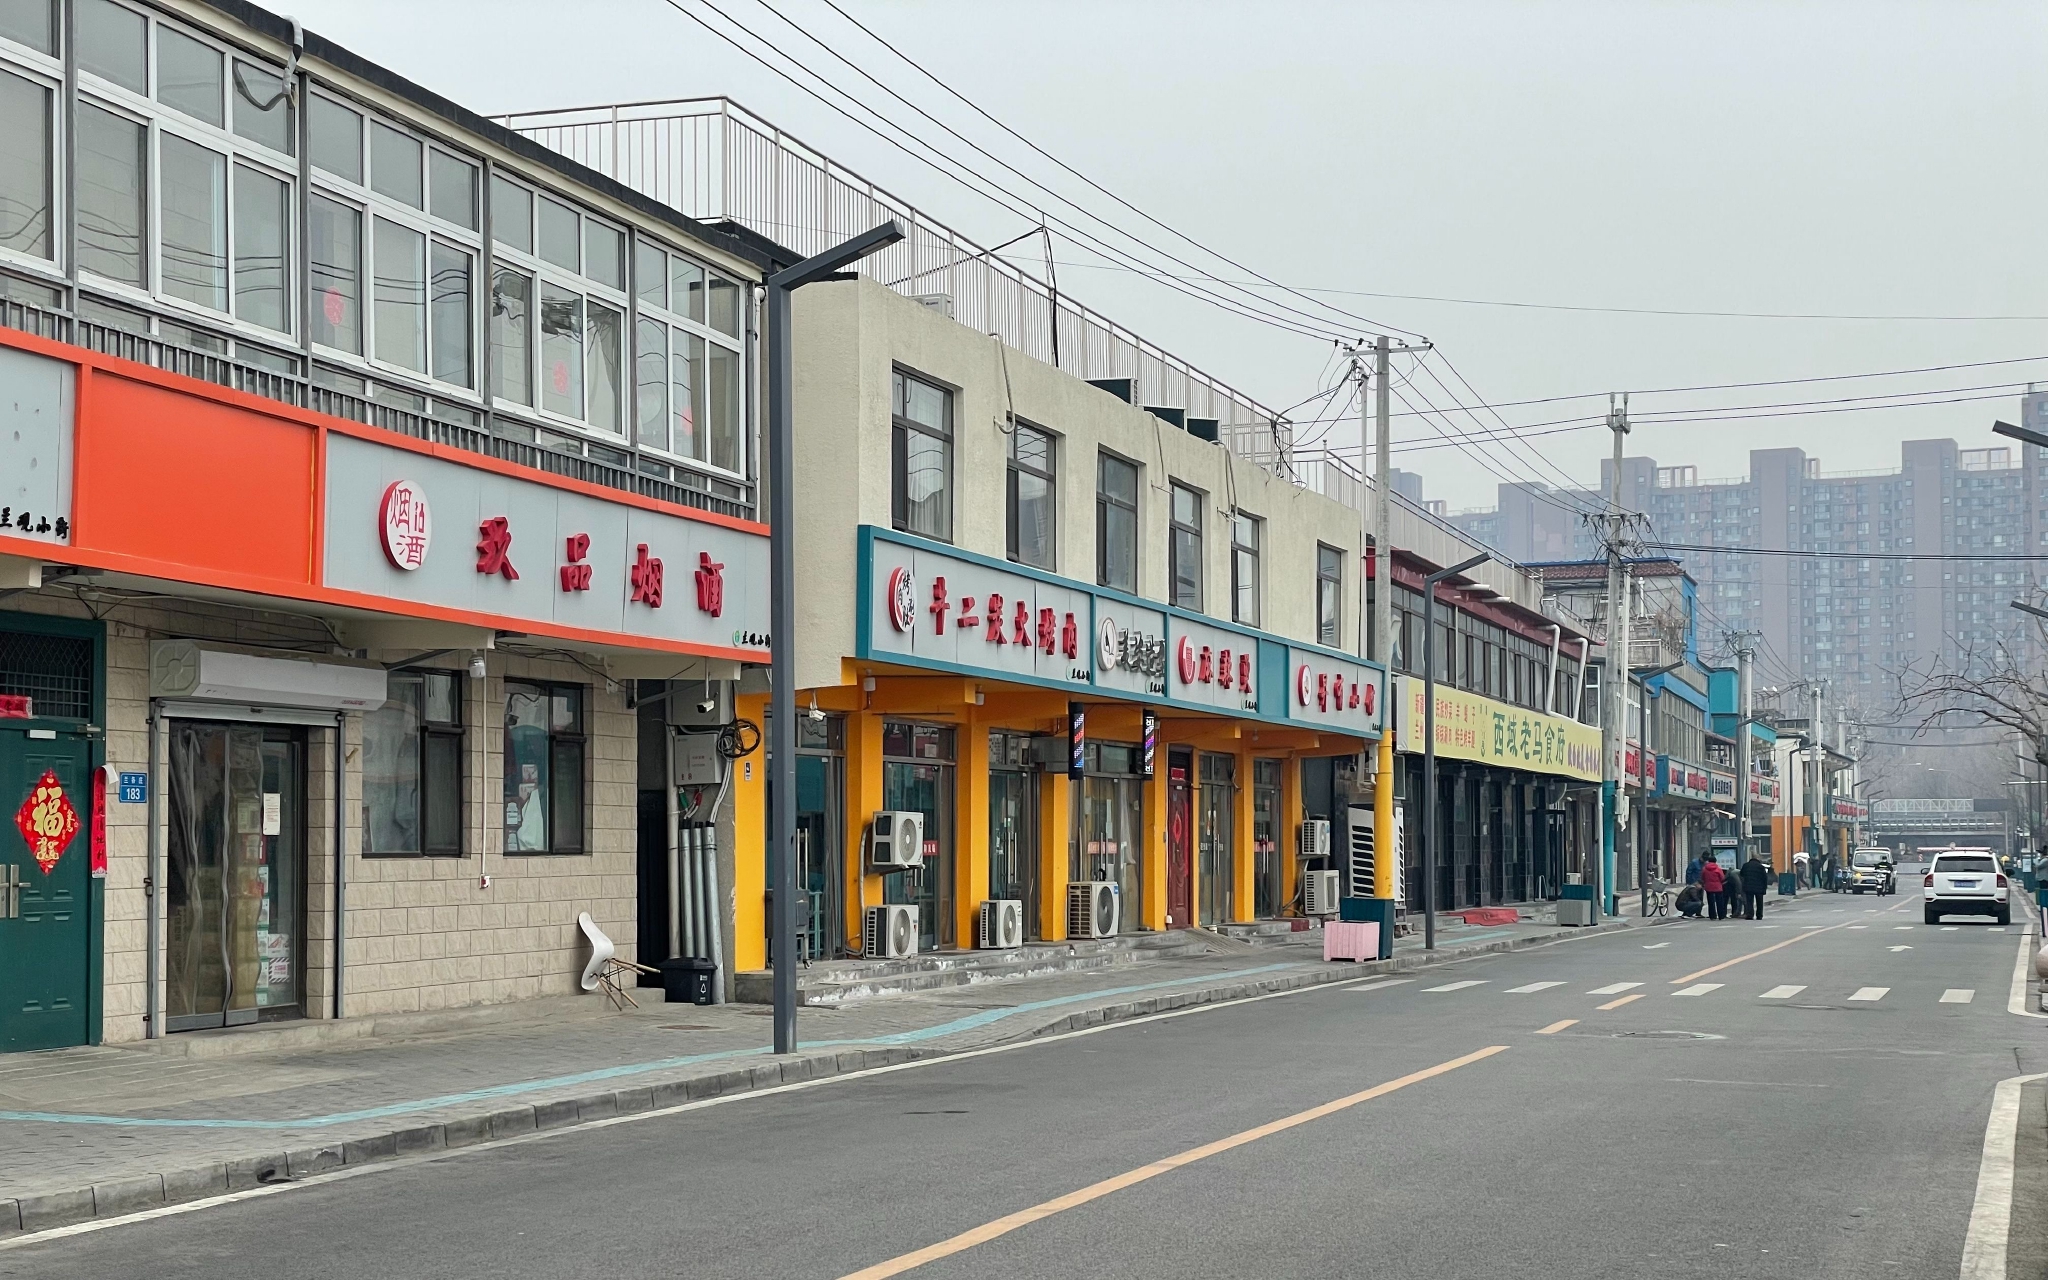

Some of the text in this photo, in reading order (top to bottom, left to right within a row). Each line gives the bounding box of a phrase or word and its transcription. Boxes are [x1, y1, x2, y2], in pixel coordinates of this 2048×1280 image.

[390, 488, 426, 566] 烟酒
[1493, 711, 1565, 765] 西域老马食府
[32, 787, 64, 836] 福
[126, 788, 140, 800] 183
